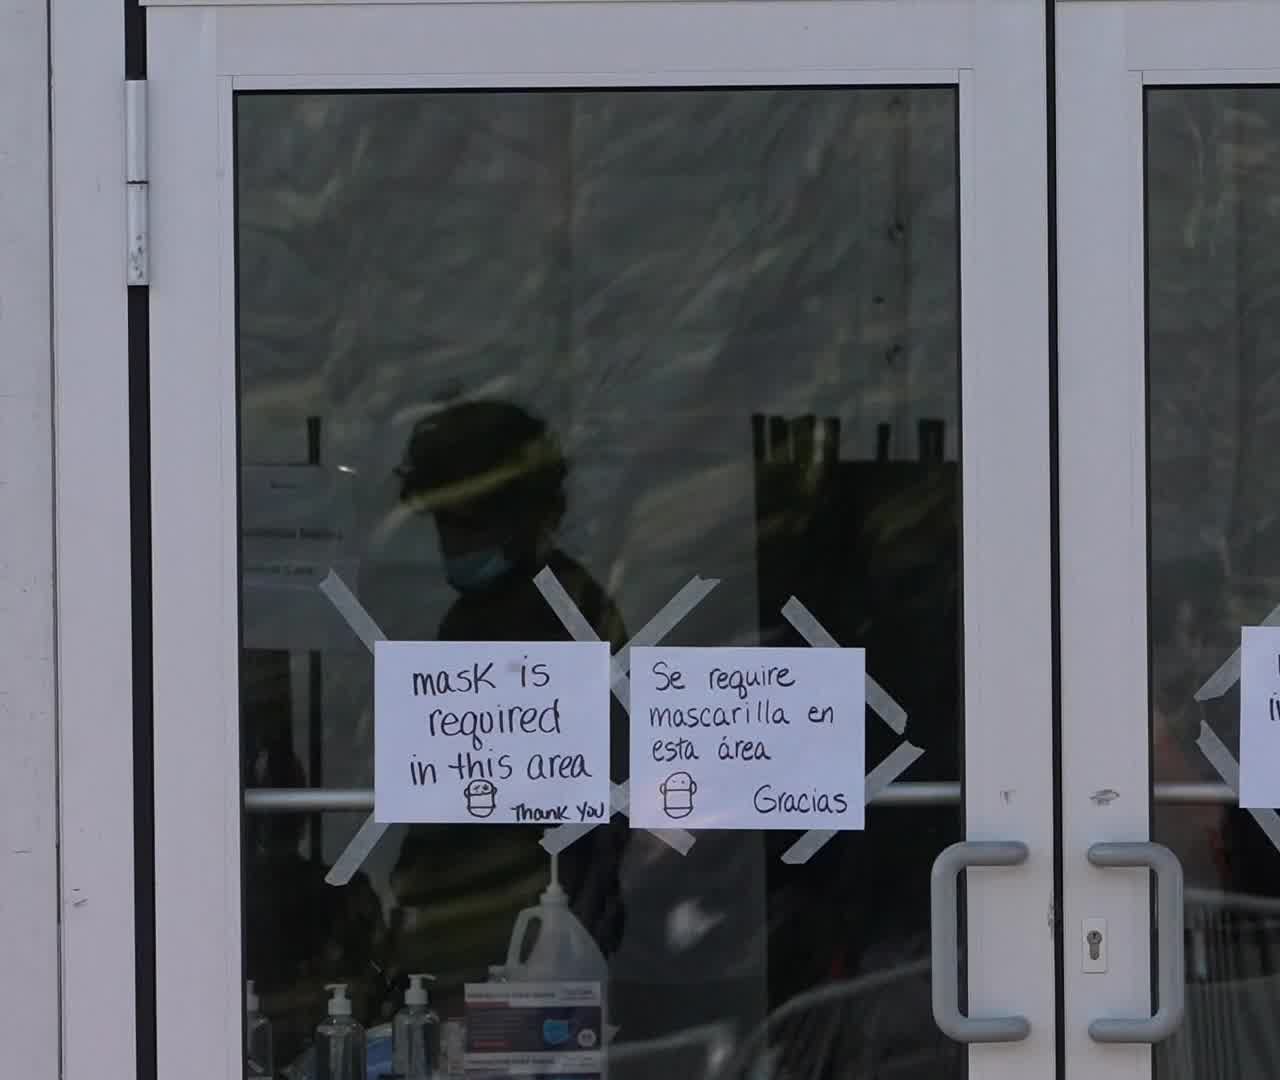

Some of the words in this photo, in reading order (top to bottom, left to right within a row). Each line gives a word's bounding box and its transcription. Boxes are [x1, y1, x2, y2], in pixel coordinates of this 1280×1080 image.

[521, 655, 550, 688] is
[652, 661, 685, 691] Se
[709, 666, 795, 699] require
[429, 698, 560, 751] required
[649, 699, 790, 728] mascarilla
[807, 705, 834, 724] en
[652, 737, 699, 762] esta
[718, 736, 771, 761] área
[410, 753, 437, 785] in
[448, 748, 513, 780] this
[527, 753, 592, 780] area
[754, 784, 848, 814] Gracias
